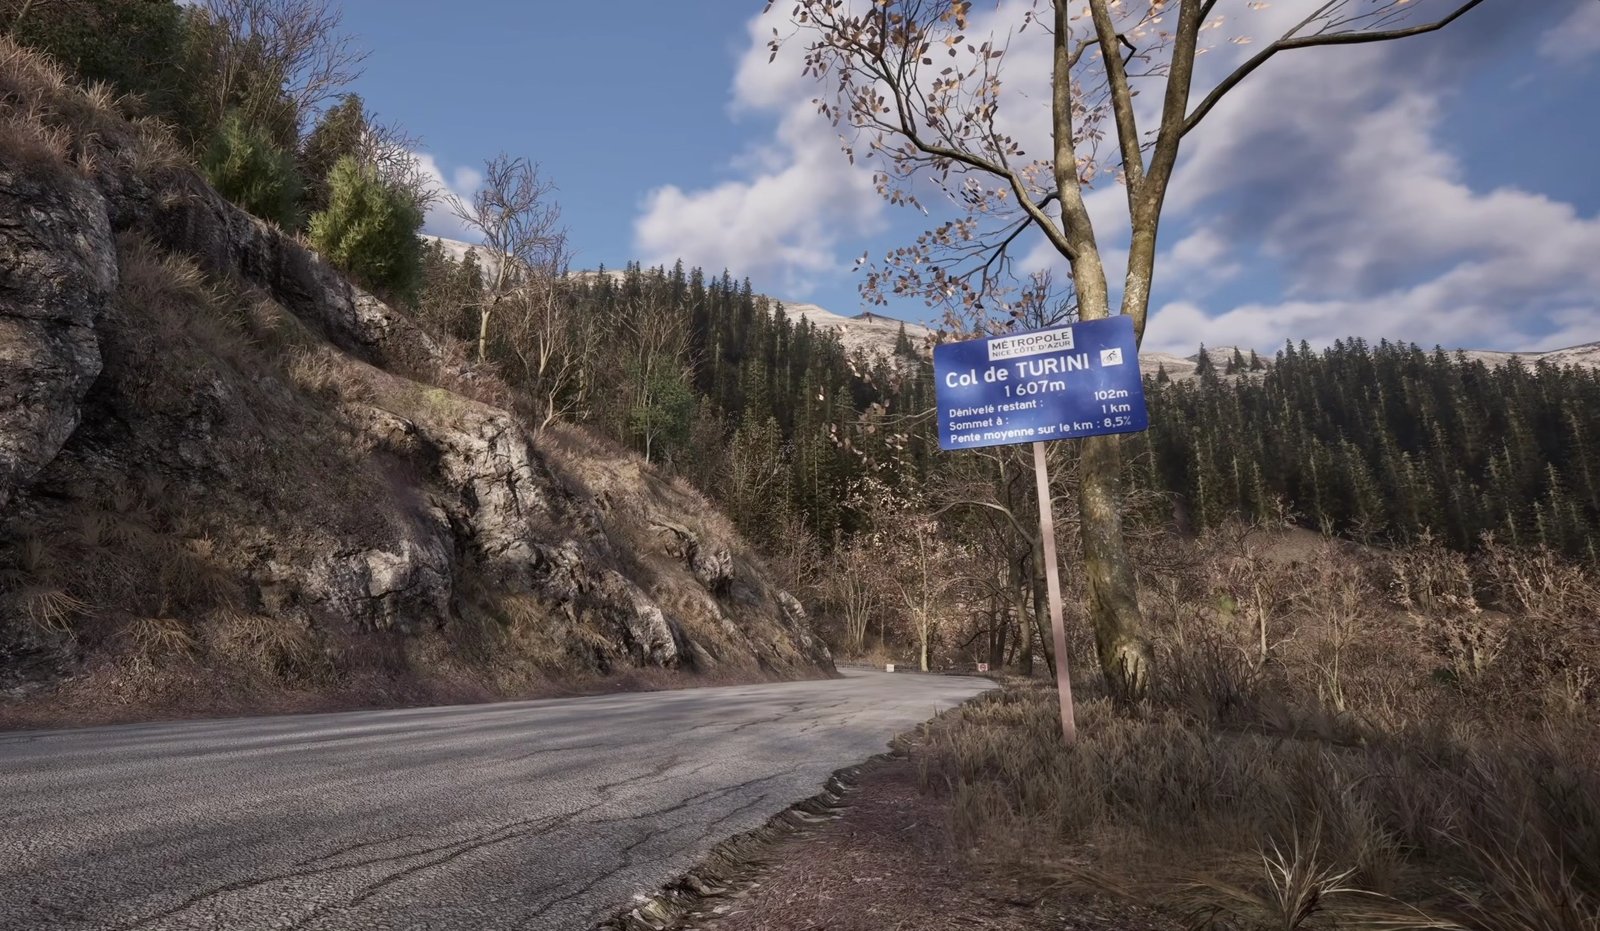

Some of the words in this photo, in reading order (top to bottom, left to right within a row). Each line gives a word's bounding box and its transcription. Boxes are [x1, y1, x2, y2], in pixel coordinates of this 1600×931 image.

[992, 332, 1069, 350] MÉTROPOLE
[1014, 345, 1036, 354] CÔTE
[1039, 341, 1071, 350] D'AZUR
[946, 371, 978, 387] Col
[984, 367, 1008, 383] de
[1016, 353, 1089, 378] TURINI
[1005, 386, 1010, 397] 1
[1016, 380, 1065, 396] 607m
[1095, 389, 1128, 400] 102m
[949, 404, 994, 418] Dénivelé
[998, 401, 1037, 412] restant
[1103, 405, 1106, 413] 1
[1111, 404, 1130, 413] km
[949, 418, 993, 431] Sommet
[996, 417, 1002, 425] à
[951, 433, 980, 443] Pente
[984, 428, 1034, 443] moyenne
[1038, 426, 1055, 435] sur
[1060, 423, 1070, 432] le
[1074, 421, 1093, 431] km
[1104, 416, 1131, 428] 8,5%
